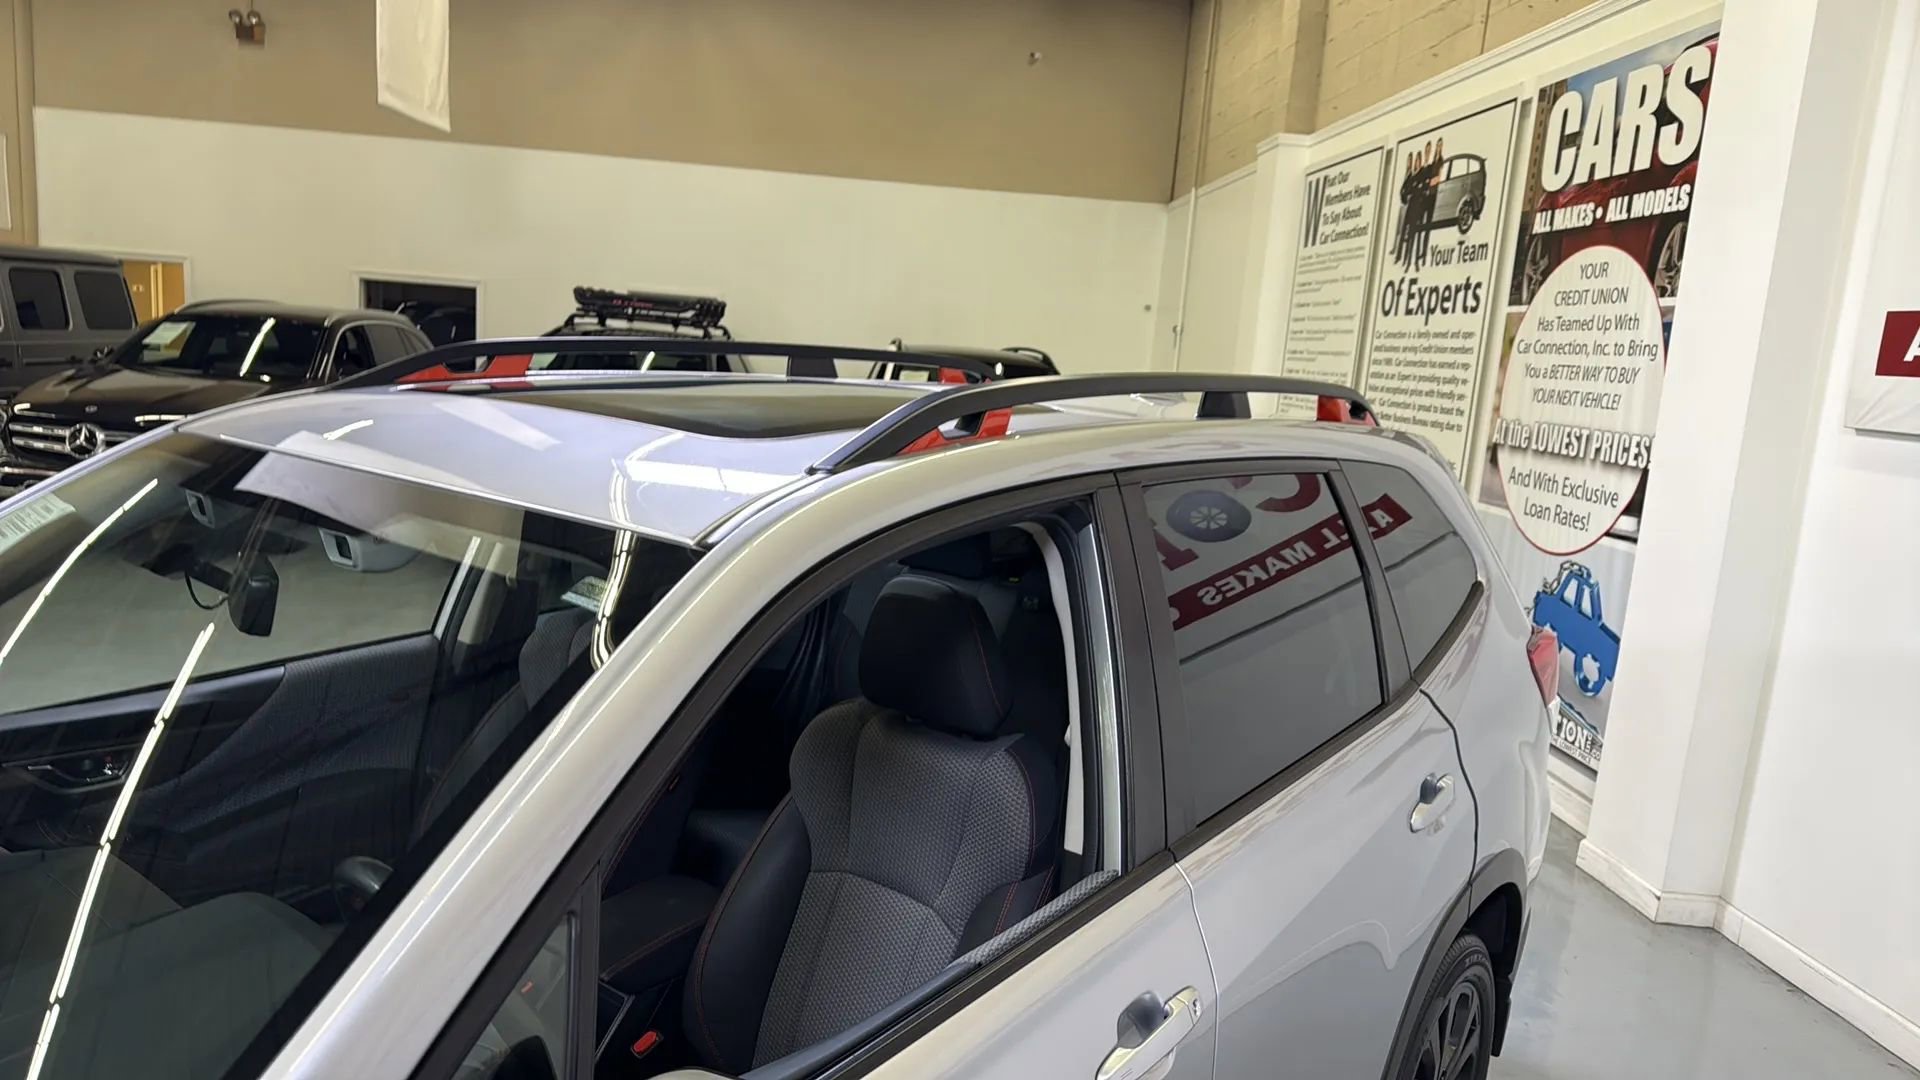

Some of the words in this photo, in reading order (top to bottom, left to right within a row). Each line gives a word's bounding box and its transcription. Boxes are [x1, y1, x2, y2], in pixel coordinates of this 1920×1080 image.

[1541, 46, 1711, 192] CARS
[1353, 184, 1371, 199] Have
[1322, 212, 1329, 226] To
[1330, 211, 1341, 226] Say
[1342, 204, 1363, 221] About
[1532, 210, 1551, 234] ALL
[1552, 202, 1595, 231] MAKES
[1605, 195, 1630, 223] ALL
[1630, 184, 1691, 218] MODELS
[1319, 232, 1330, 245] Car
[1430, 244, 1455, 267] Your
[1457, 240, 1489, 264] Team
[1580, 261, 1609, 280] YOUR
[1382, 276, 1405, 317] Of
[1404, 275, 1483, 327] Experts
[1554, 289, 1590, 307] CREDIT
[1591, 287, 1629, 305] UNION
[1537, 316, 1554, 331] Has
[1555, 315, 1593, 332] Teamed
[1597, 314, 1612, 334] Up
[1615, 313, 1640, 331] With
[1517, 339, 1532, 354] Car
[1533, 339, 1590, 358] Connection,
[1592, 340, 1610, 356] Inc.
[1614, 344, 1625, 357] to
[1627, 340, 1658, 361] Bring
[1525, 363, 1541, 378] You
[1542, 370, 1548, 379] a
[1549, 364, 1581, 381] BETTER
[1582, 366, 1603, 382] WAY
[1603, 366, 1617, 383] TO
[1618, 367, 1641, 384] BUY
[1532, 388, 1556, 404] YOUR
[1556, 389, 1580, 406] NEXT
[1580, 391, 1622, 410] VEHICLE!
[1492, 418, 1507, 445] At
[1508, 419, 1530, 448] the
[1531, 422, 1590, 459] LOWEST
[1508, 466, 1531, 488] And
[1533, 470, 1558, 495] With
[1561, 477, 1619, 508] Exclusive
[1523, 497, 1550, 522] Loan
[1553, 503, 1591, 532] Rates!
